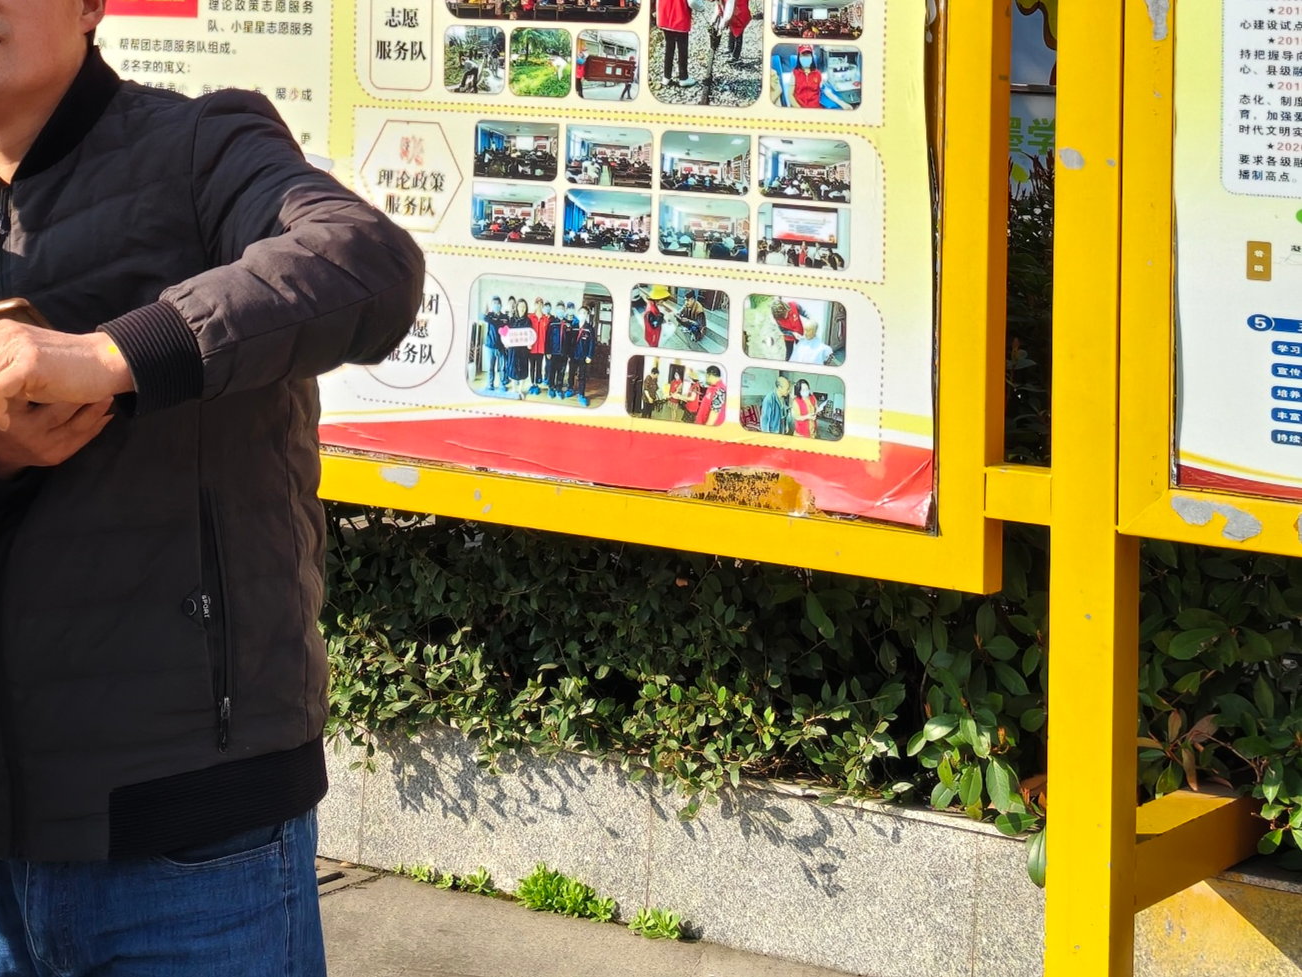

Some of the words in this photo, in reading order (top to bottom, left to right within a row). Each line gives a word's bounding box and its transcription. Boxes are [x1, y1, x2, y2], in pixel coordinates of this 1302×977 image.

[385, 7, 419, 28] 志愿
[1277, 6, 1302, 16] 201
[207, 19, 314, 36] 队、小星星志愿服务
[1277, 36, 1302, 46] 201
[375, 39, 427, 62] 服务队
[1277, 82, 1302, 91] 201
[1238, 124, 1302, 137] 时代文明实
[377, 168, 446, 192] 理论政策
[385, 194, 435, 216] 服务队
[1254, 317, 1267, 329] 5
[1277, 344, 1301, 354] 学习
